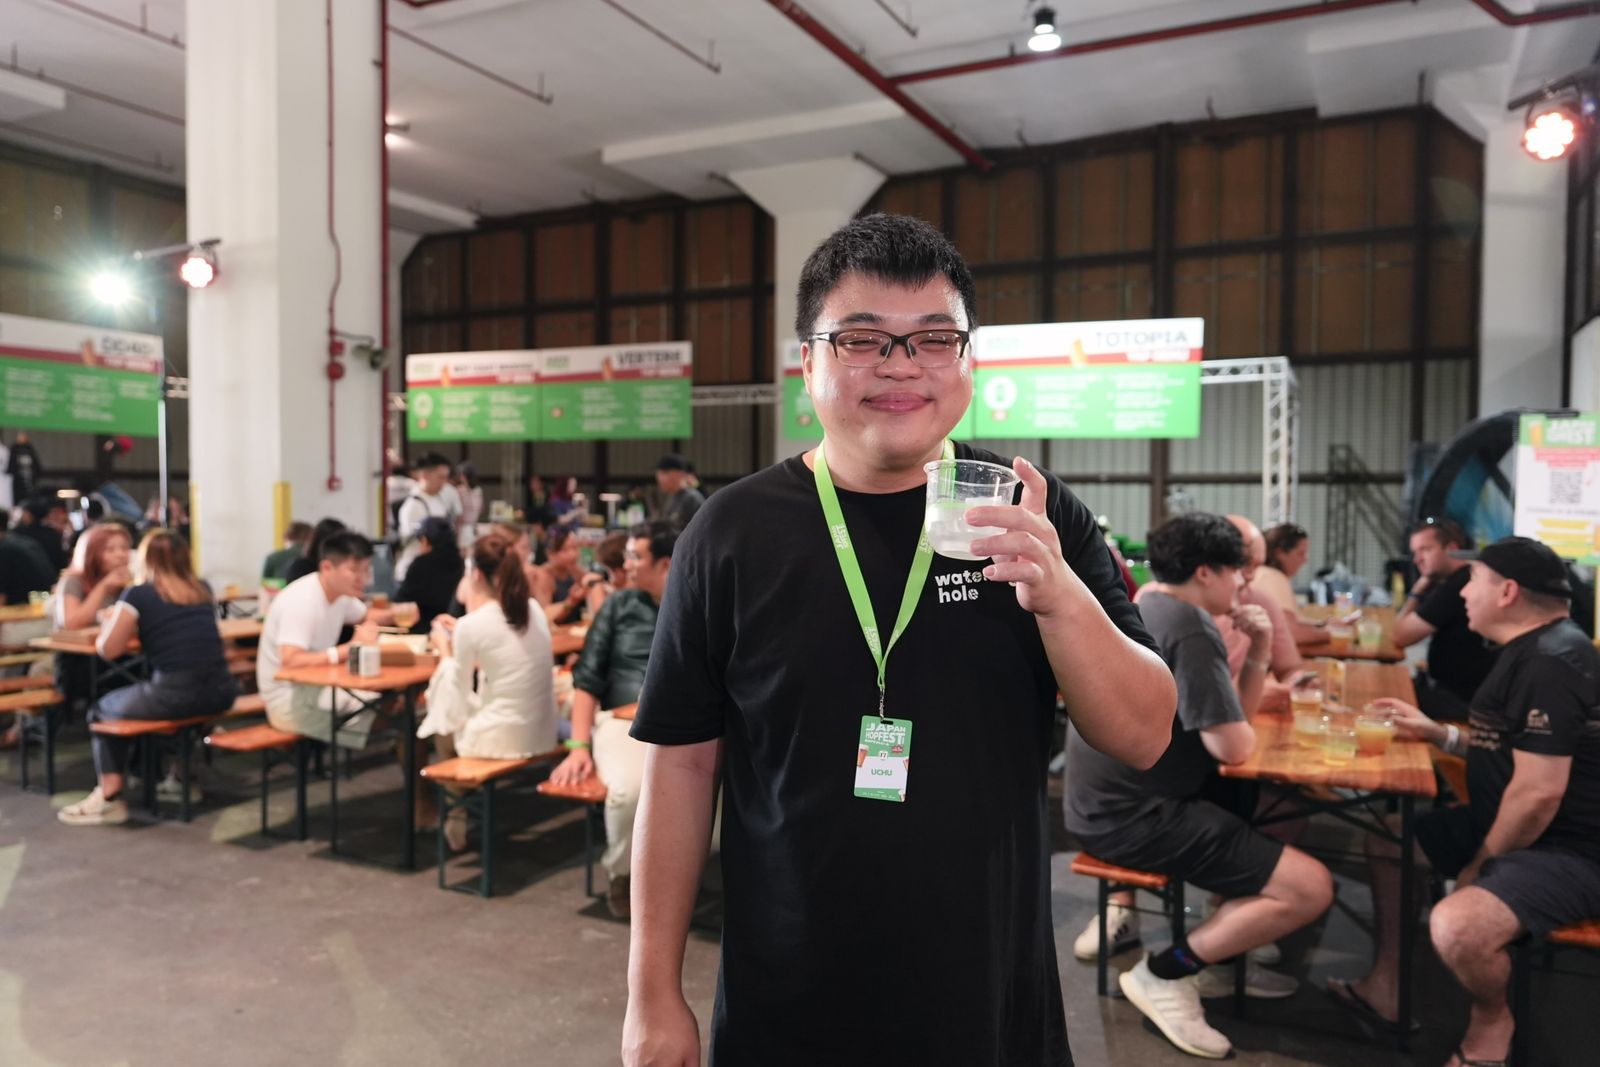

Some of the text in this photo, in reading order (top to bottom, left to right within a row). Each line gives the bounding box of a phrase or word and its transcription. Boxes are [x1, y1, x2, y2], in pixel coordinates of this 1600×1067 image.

[1095, 331, 1188, 347] TOTOPIA
[938, 585, 979, 604] hole
[866, 723, 905, 732] JAPAN
